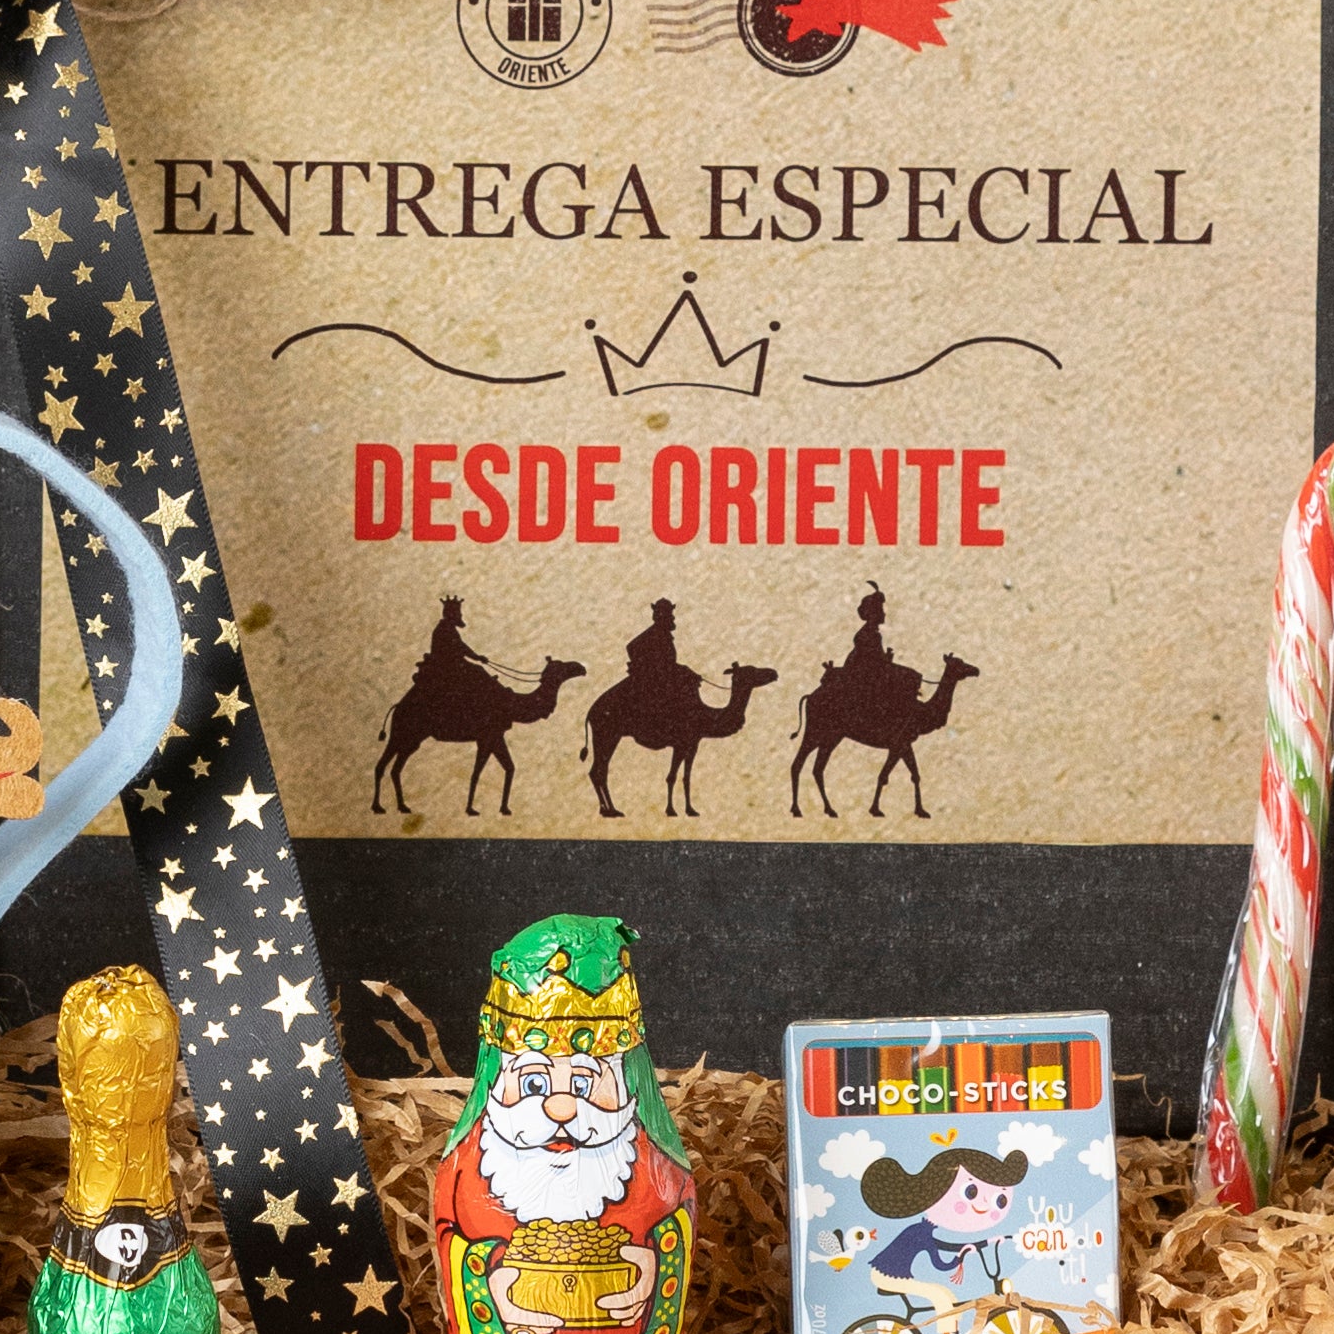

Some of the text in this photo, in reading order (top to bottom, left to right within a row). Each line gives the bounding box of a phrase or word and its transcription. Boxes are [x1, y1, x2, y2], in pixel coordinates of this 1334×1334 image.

[498, 57, 572, 83] ORIENTE
[154, 158, 1214, 245] ENTREGA ESPECIAL
[354, 442, 1006, 546] DESDE ORIENTE
[837, 1078, 1067, 1106] CHOCO-STICKS
[1022, 1221, 1104, 1251] can do
